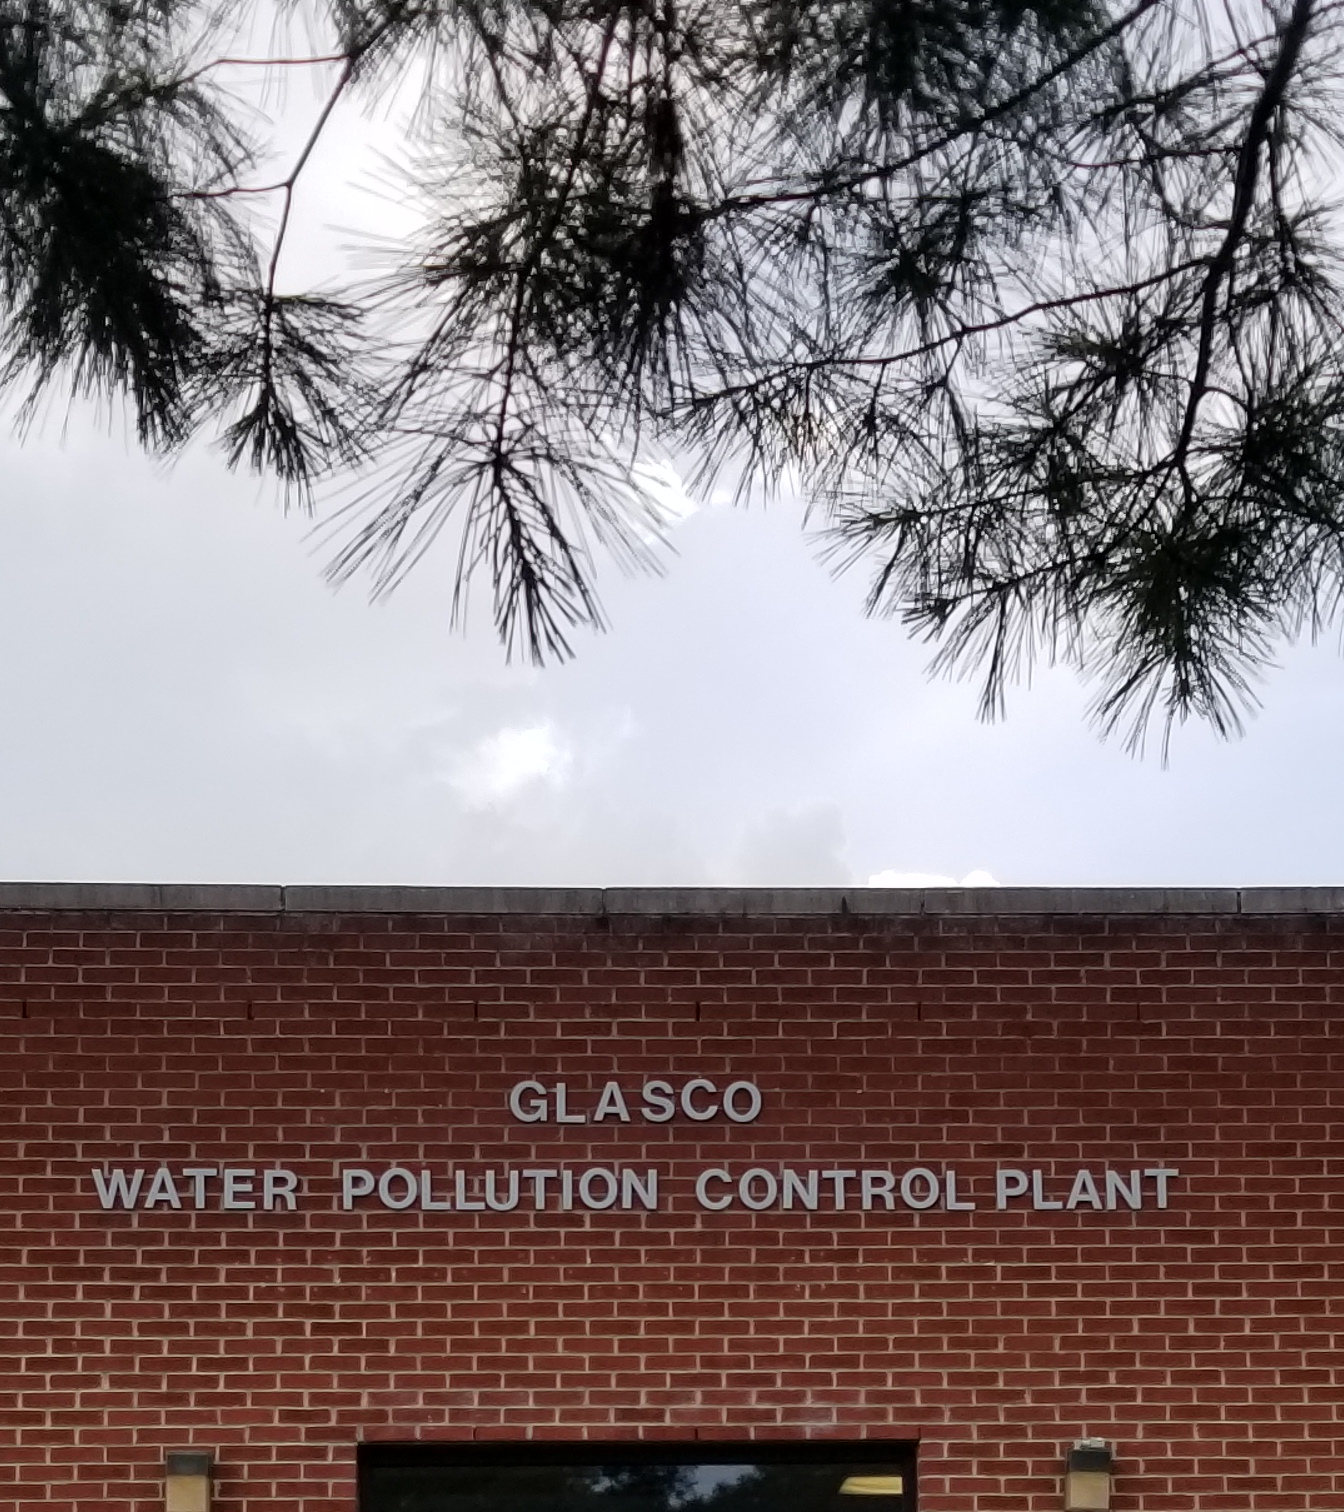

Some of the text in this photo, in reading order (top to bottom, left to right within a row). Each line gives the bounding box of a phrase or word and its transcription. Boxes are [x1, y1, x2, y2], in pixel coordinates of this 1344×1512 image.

[508, 1079, 763, 1125] GLASCO
[90, 1166, 1180, 1212] WATER POLLUTION CONTROL PLANT
